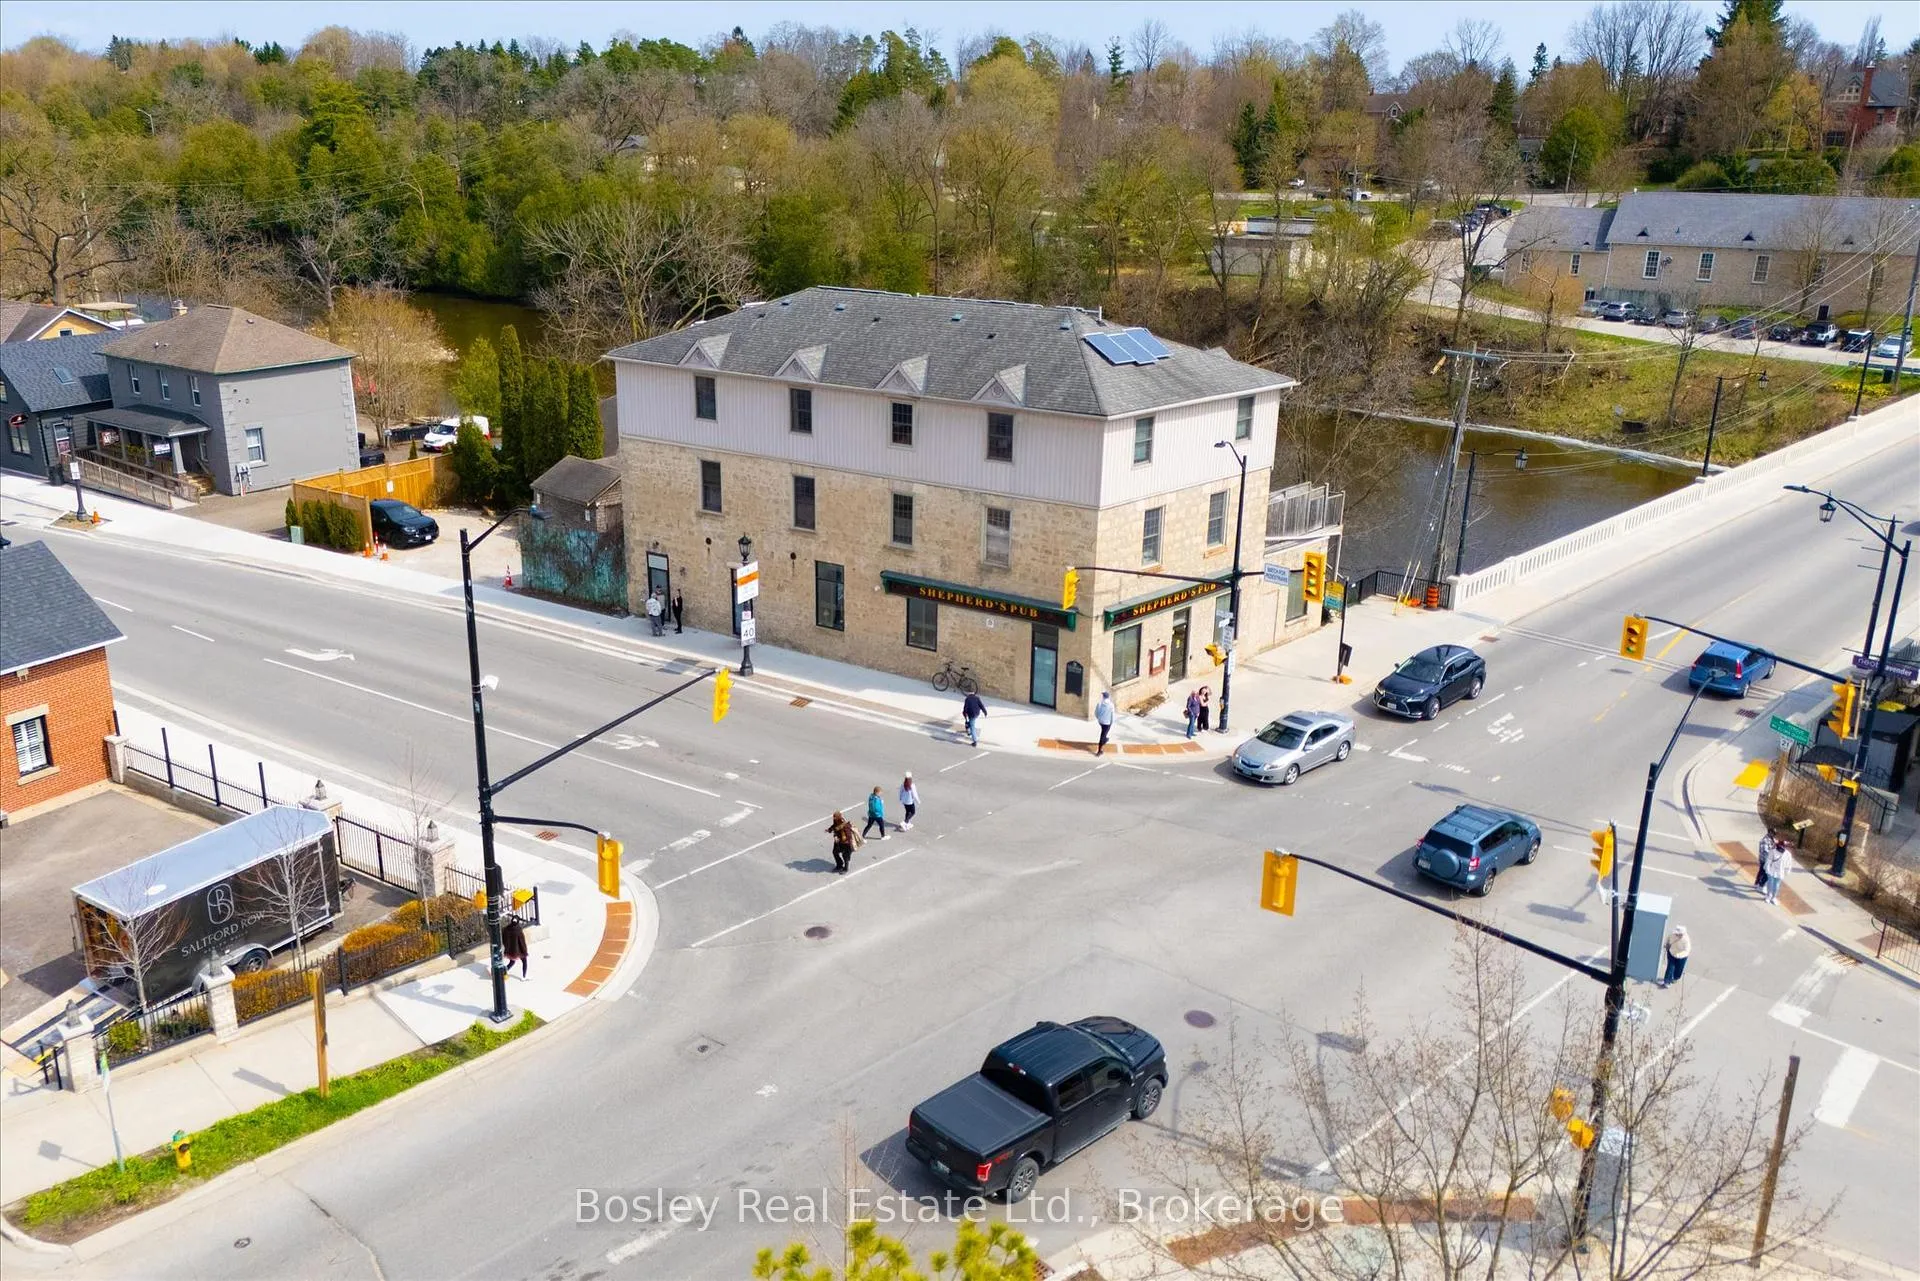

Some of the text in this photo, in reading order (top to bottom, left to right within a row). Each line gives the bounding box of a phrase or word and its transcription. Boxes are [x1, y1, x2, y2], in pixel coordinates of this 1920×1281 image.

[919, 587, 1039, 618] SHEPHERD'S PUB
[1133, 583, 1217, 616] SHEPHERD'S PUB
[743, 627, 754, 637] 40
[181, 923, 239, 958] SALTFORD
[240, 911, 266, 929] ROW
